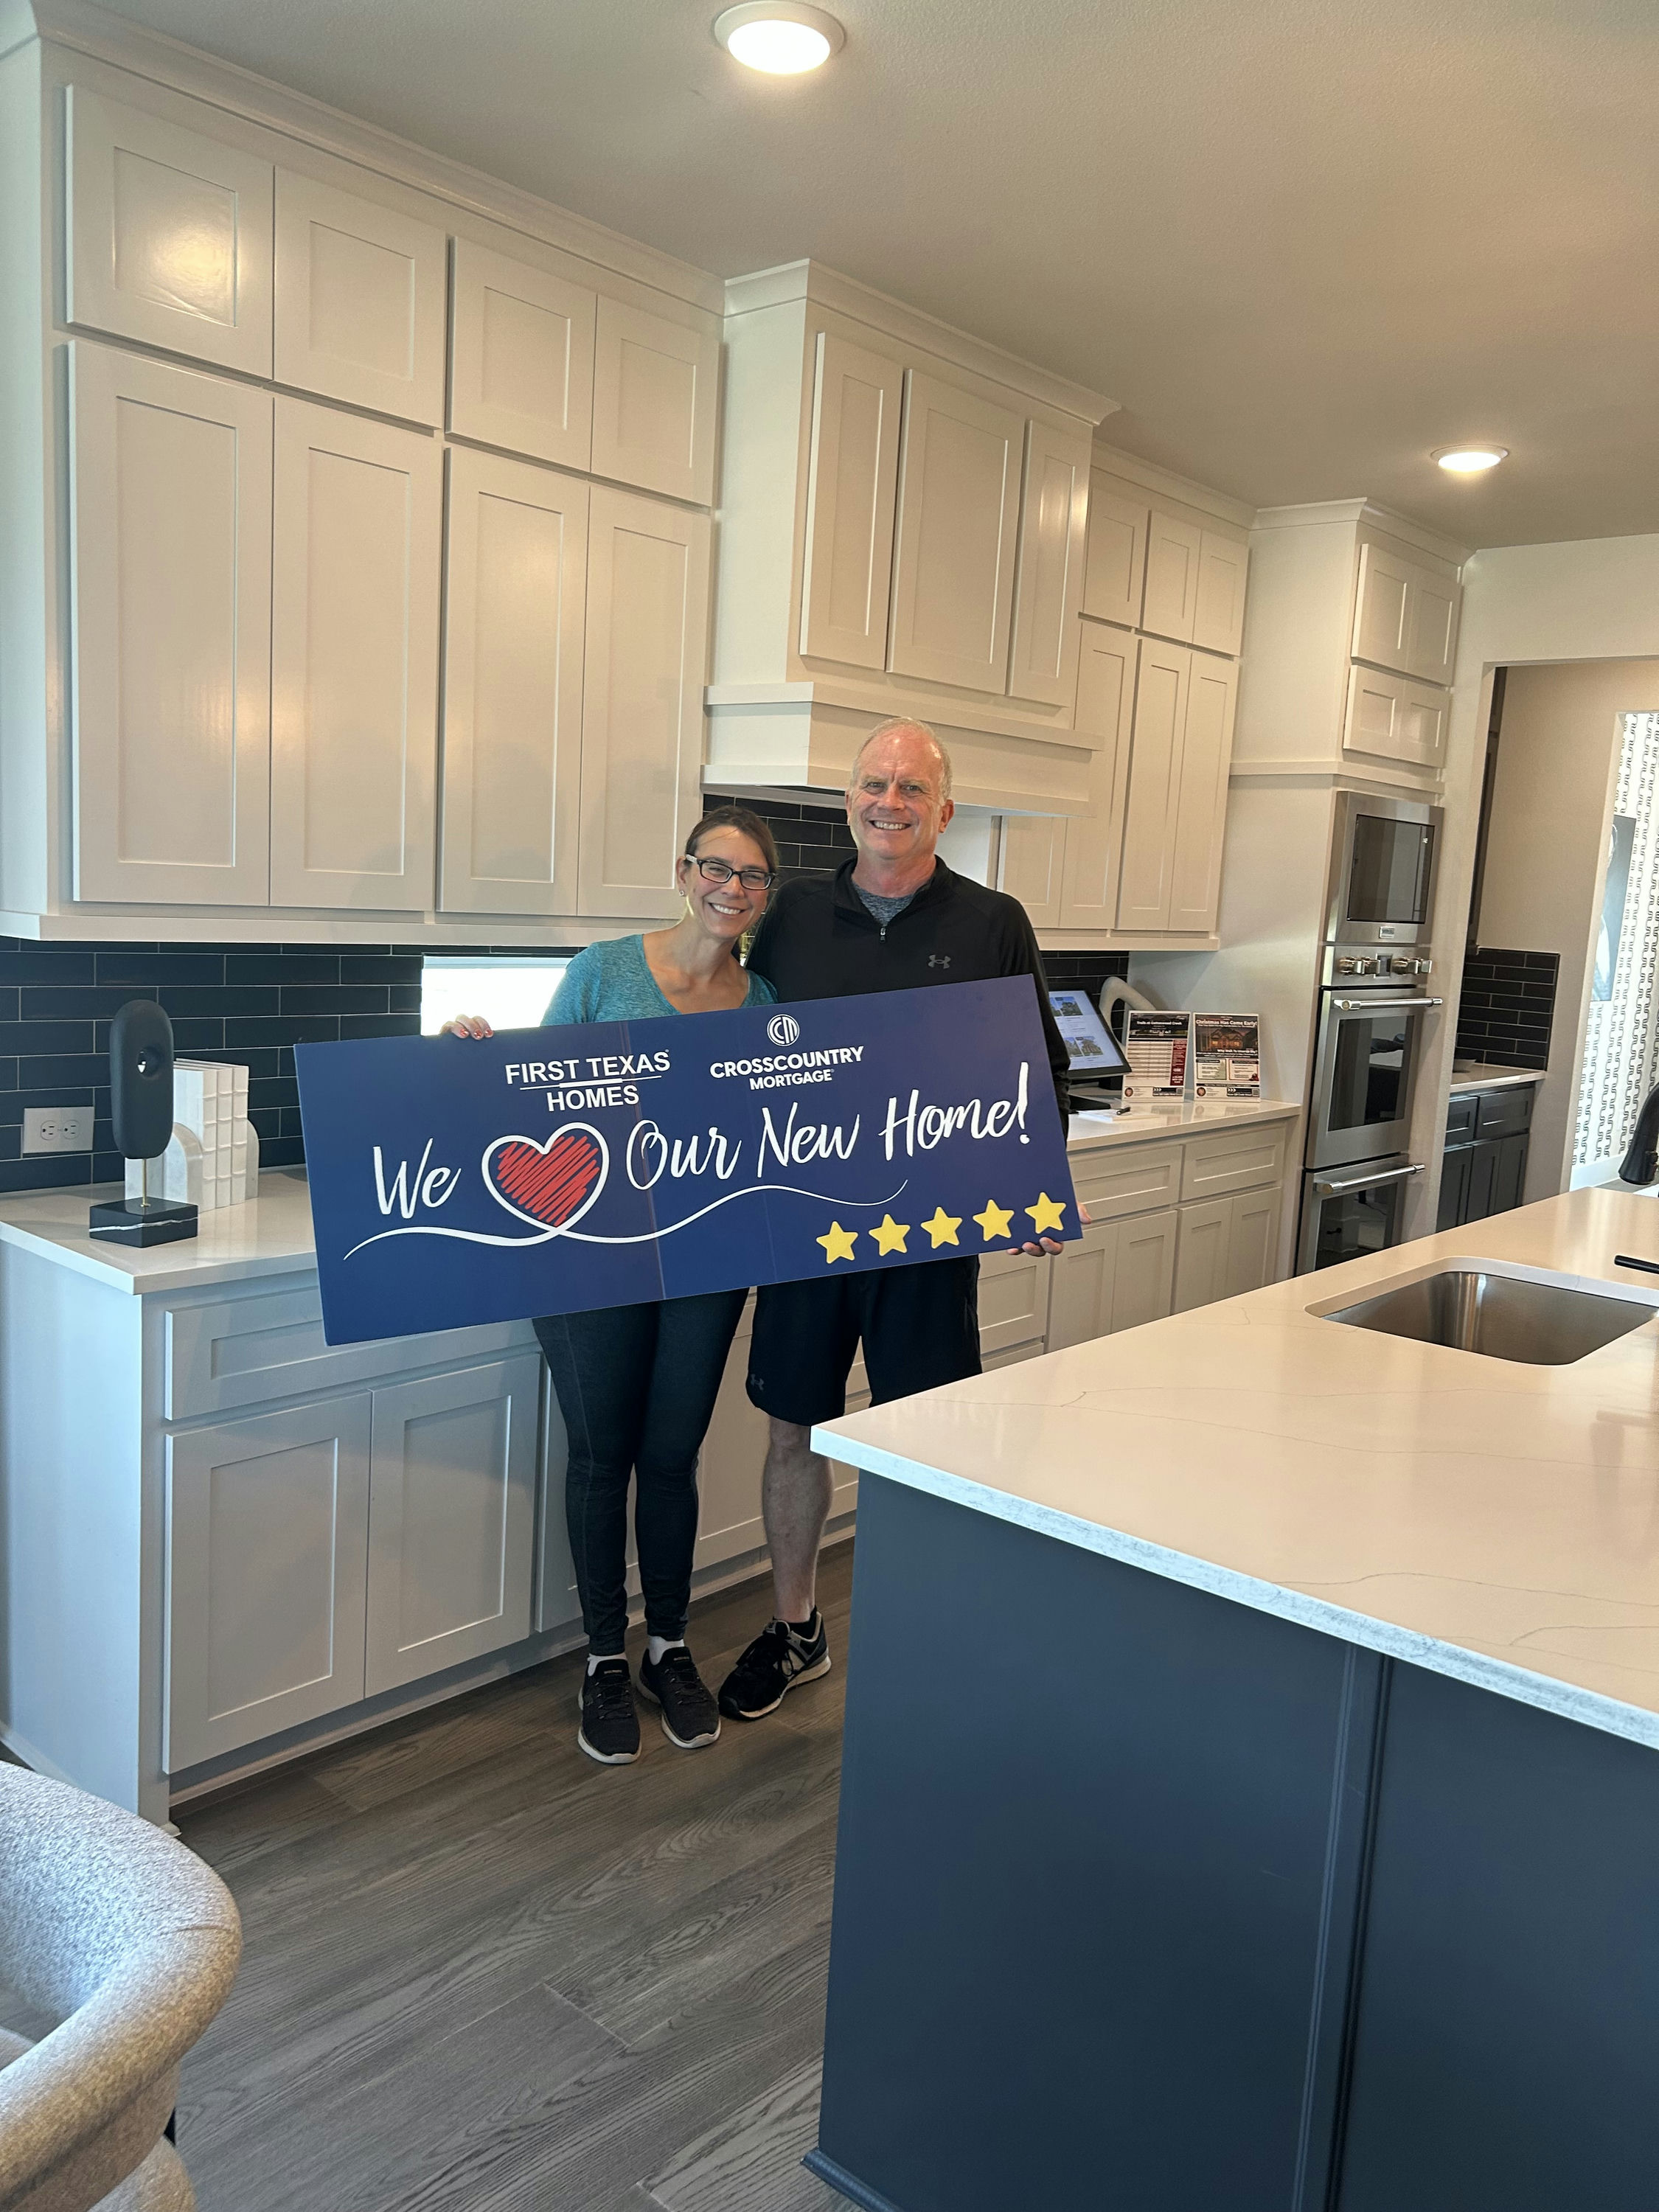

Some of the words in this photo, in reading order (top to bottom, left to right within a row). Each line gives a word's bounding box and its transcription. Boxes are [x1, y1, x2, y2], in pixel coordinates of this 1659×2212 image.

[505, 1059, 580, 1085] FIRST
[585, 1051, 671, 1077] TEXAS
[709, 1046, 864, 1079] CROSSCOUNTRY
[749, 1069, 832, 1091] MORTGAGE
[546, 1085, 640, 1112] HOMES
[372, 1138, 462, 1219] We
[626, 1119, 742, 1190] Our
[757, 1102, 860, 1178] New
[877, 1062, 1030, 1161] Home!
